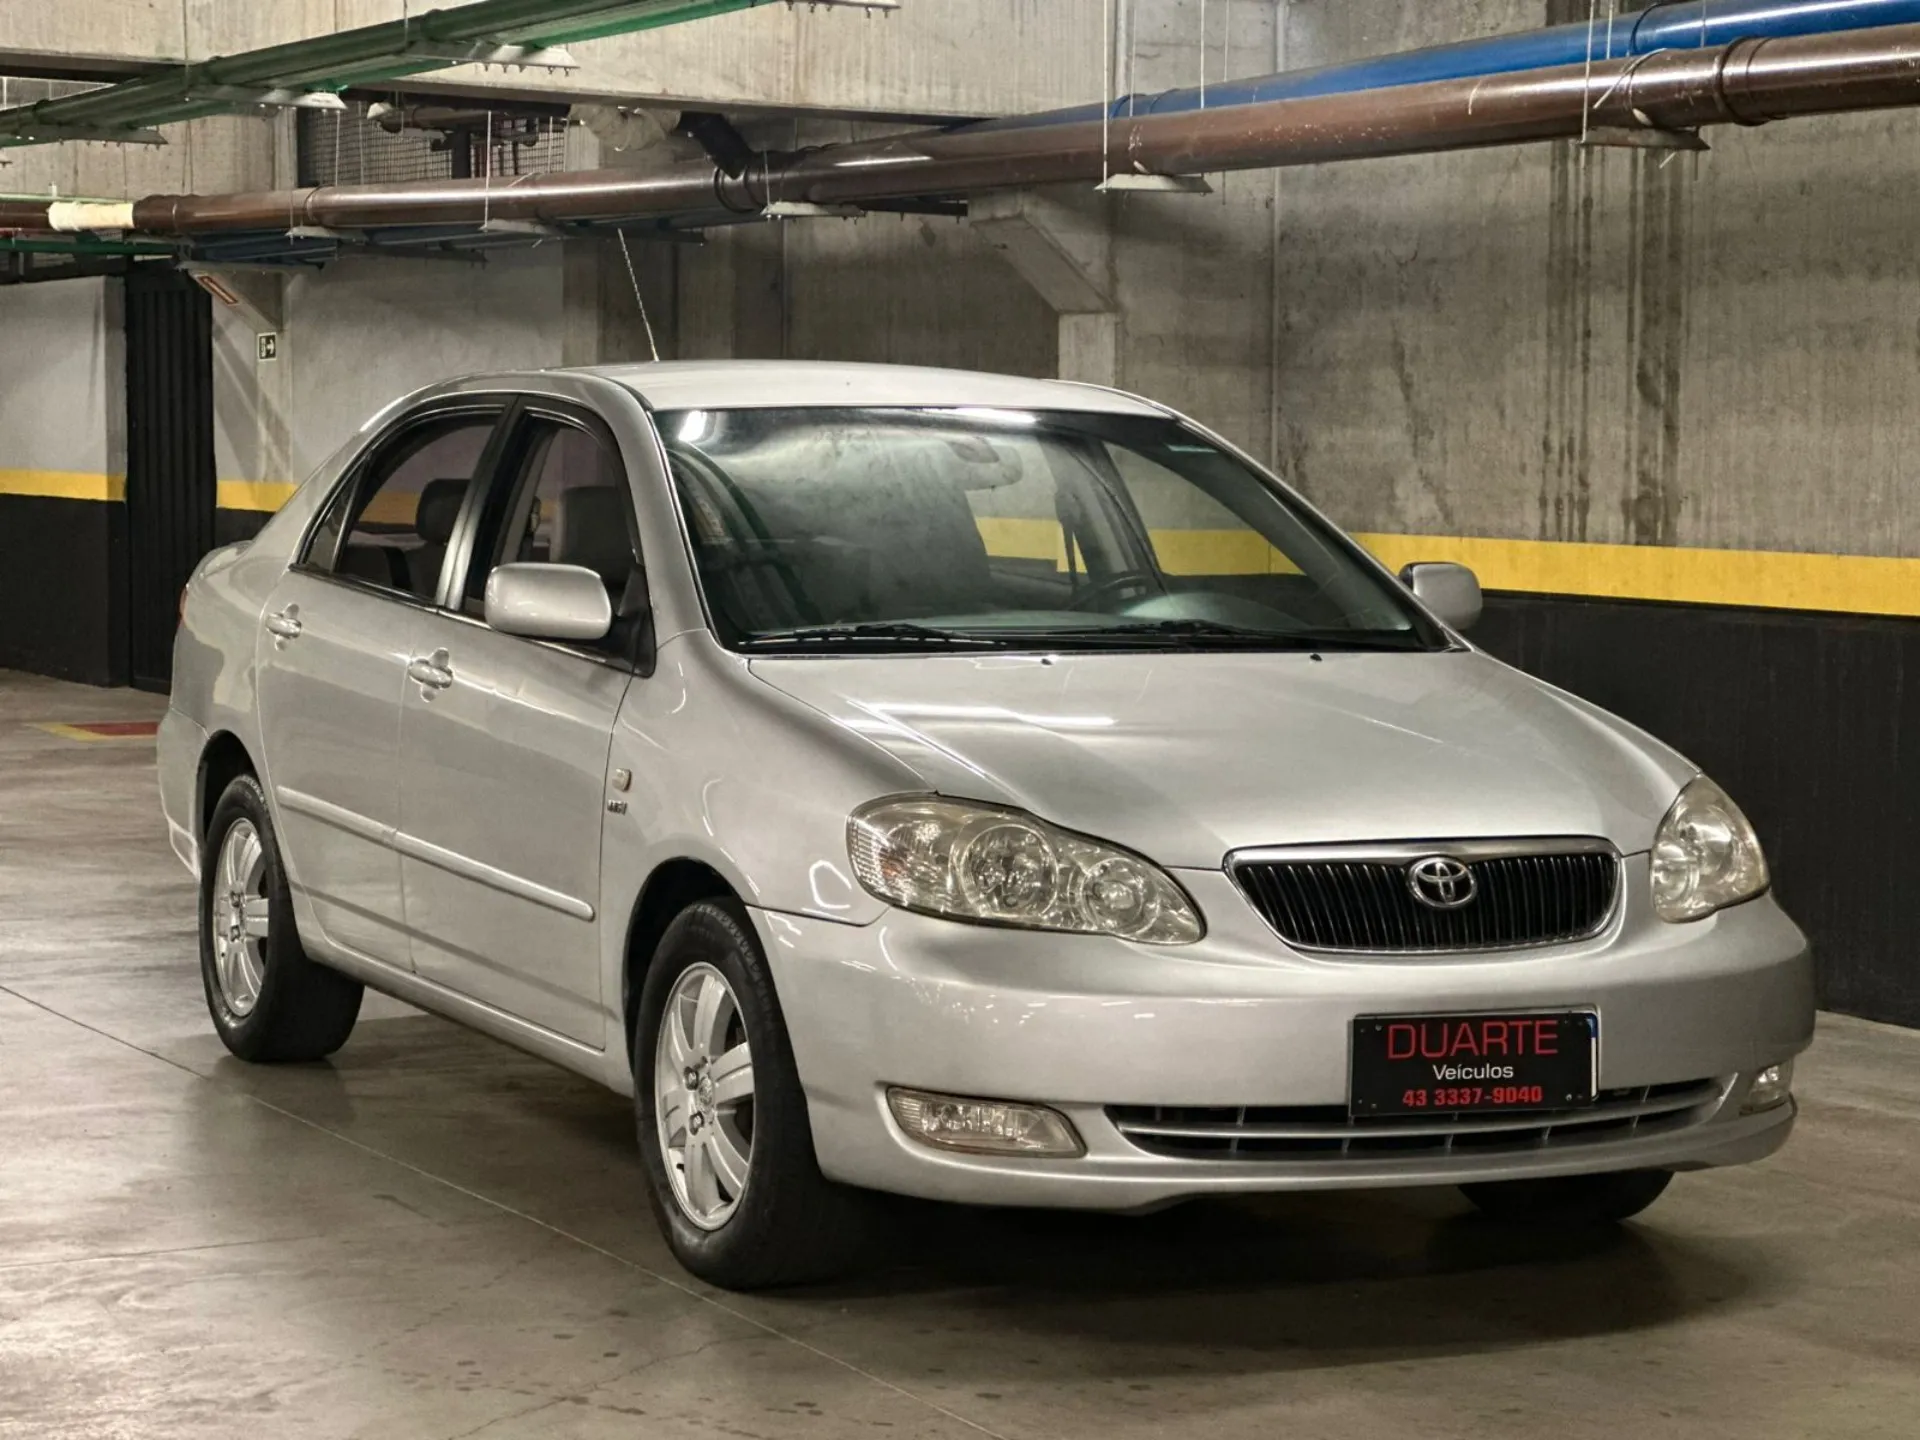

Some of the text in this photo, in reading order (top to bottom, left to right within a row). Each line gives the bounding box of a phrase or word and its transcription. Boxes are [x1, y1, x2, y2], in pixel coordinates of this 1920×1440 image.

[1387, 1020, 1558, 1060] DUARTE
[1432, 1063, 1514, 1081] Veículos
[1402, 1086, 1543, 1107] 43 3337-9040
